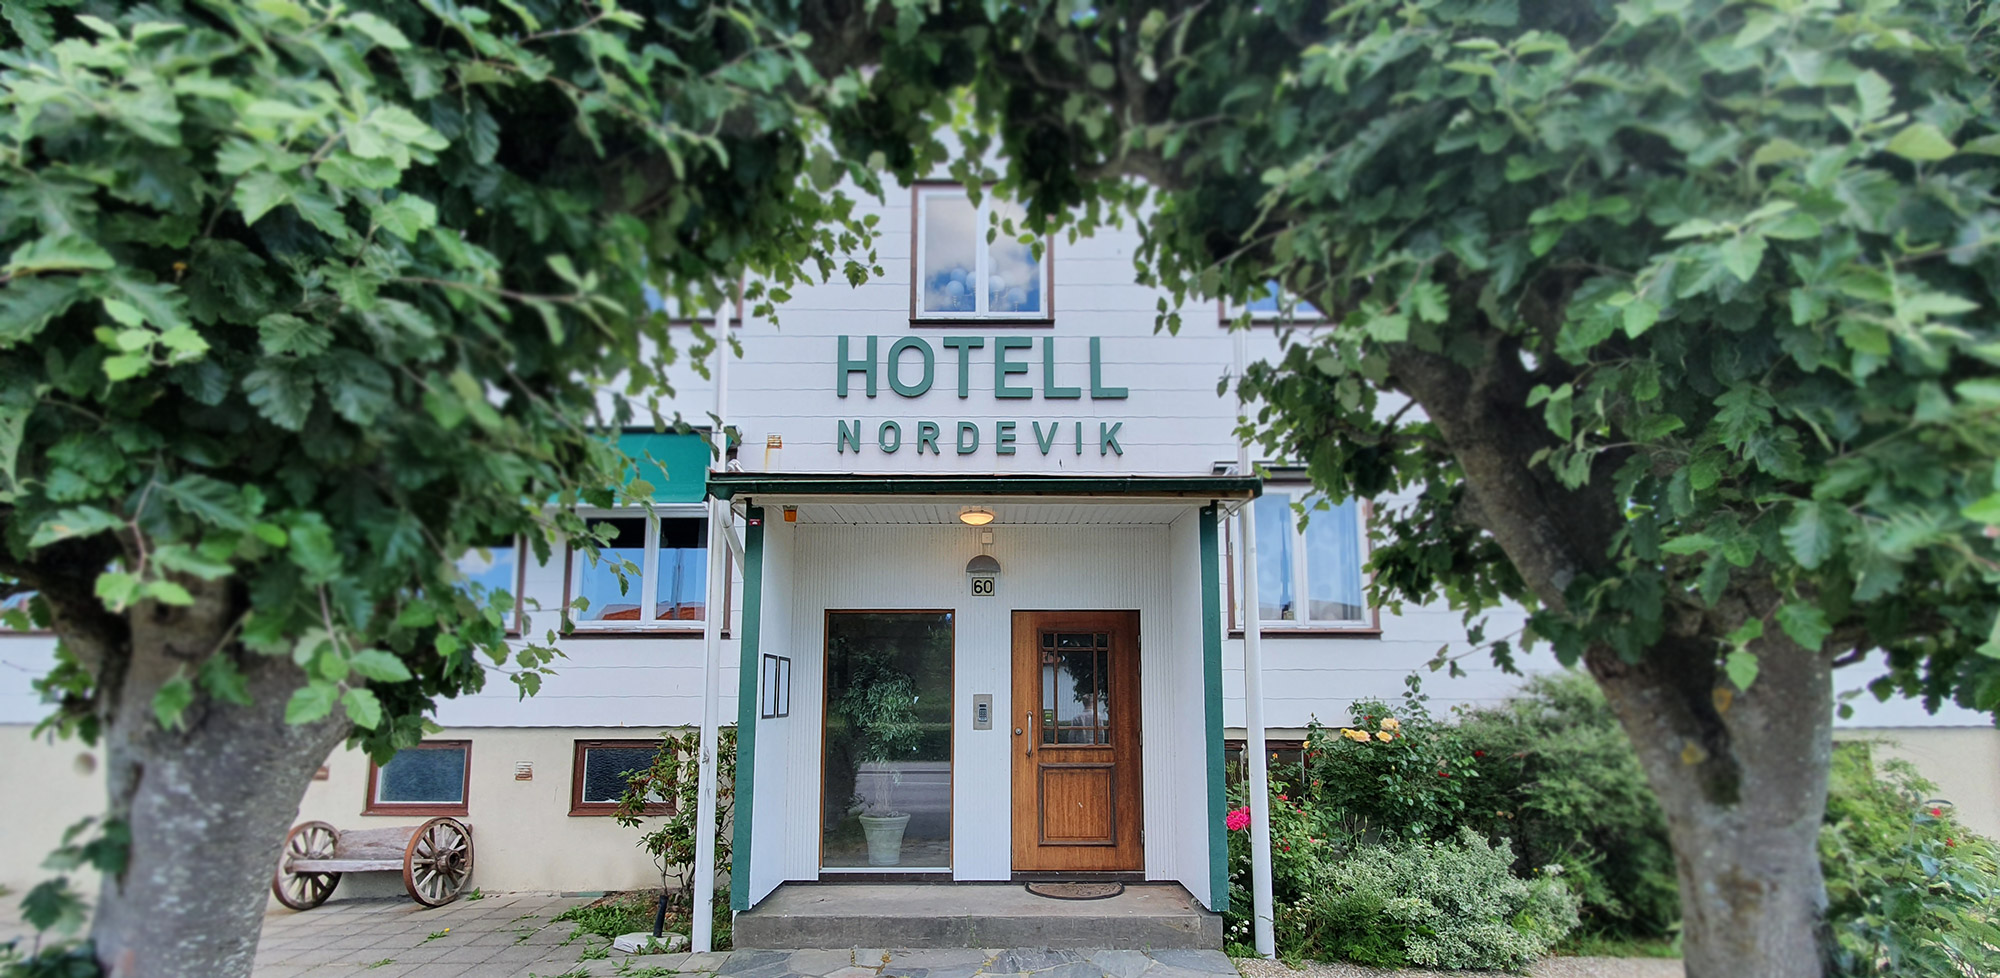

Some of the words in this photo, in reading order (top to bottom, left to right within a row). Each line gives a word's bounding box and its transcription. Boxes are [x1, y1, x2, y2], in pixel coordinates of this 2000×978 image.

[836, 335, 1129, 399] HOTELL
[837, 419, 1124, 455] NORDEVIK
[974, 580, 993, 594] 60
